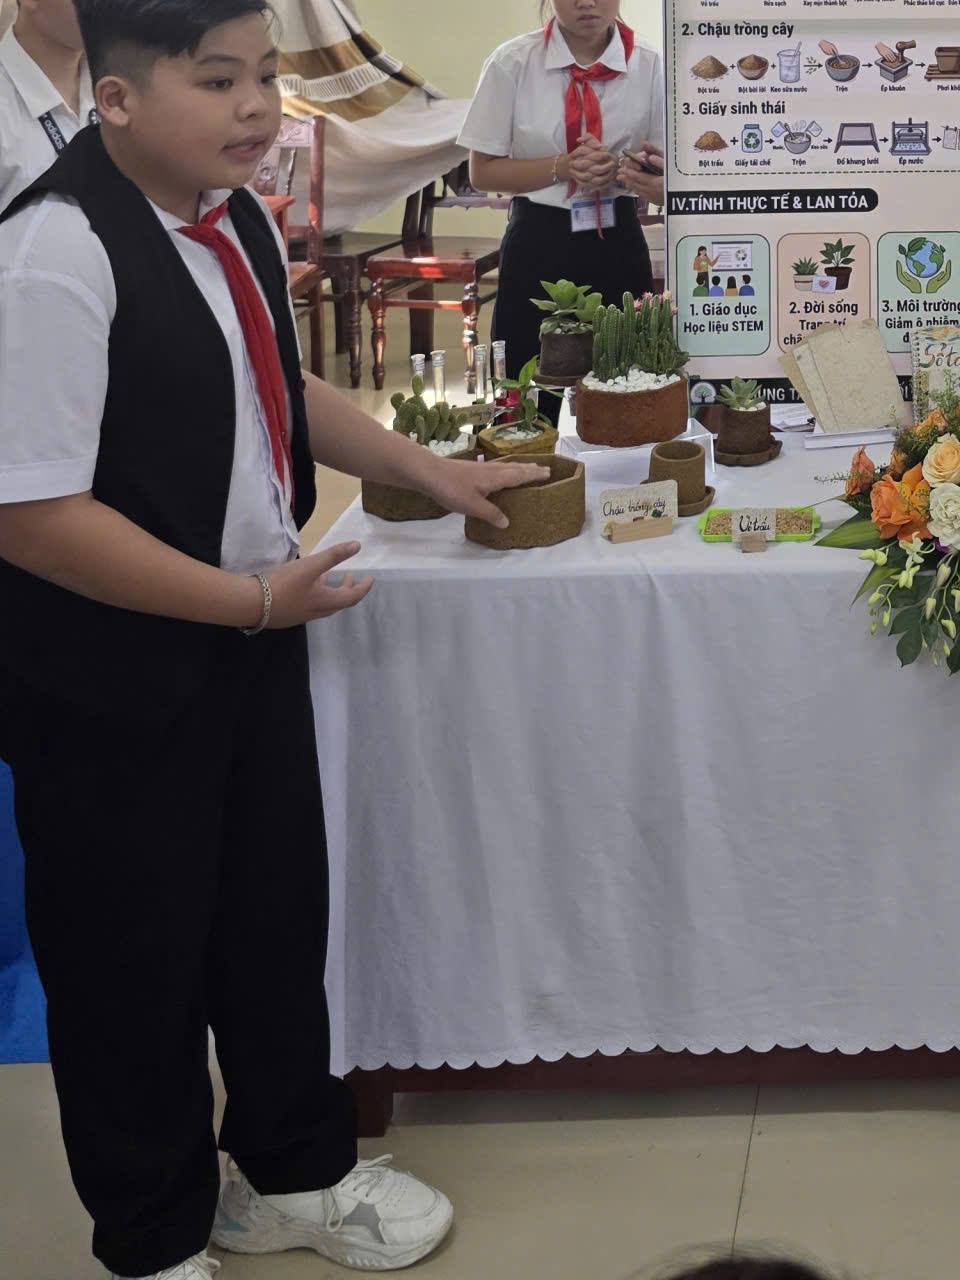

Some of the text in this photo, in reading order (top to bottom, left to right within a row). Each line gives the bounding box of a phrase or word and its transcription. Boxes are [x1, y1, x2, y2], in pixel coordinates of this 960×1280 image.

[682, 21, 794, 38] 2. Chậu trồng cây
[683, 100, 785, 116] 3. Giấy sinh thái
[45, 120, 64, 149] adidas
[725, 195, 768, 213] THỰC
[771, 192, 790, 210] TẾ
[793, 196, 802, 209] &
[807, 196, 835, 208] LAN
[839, 191, 868, 208] TỎA
[689, 302, 757, 318] 1. Giáo dục
[684, 320, 764, 335] Học liệu STEM
